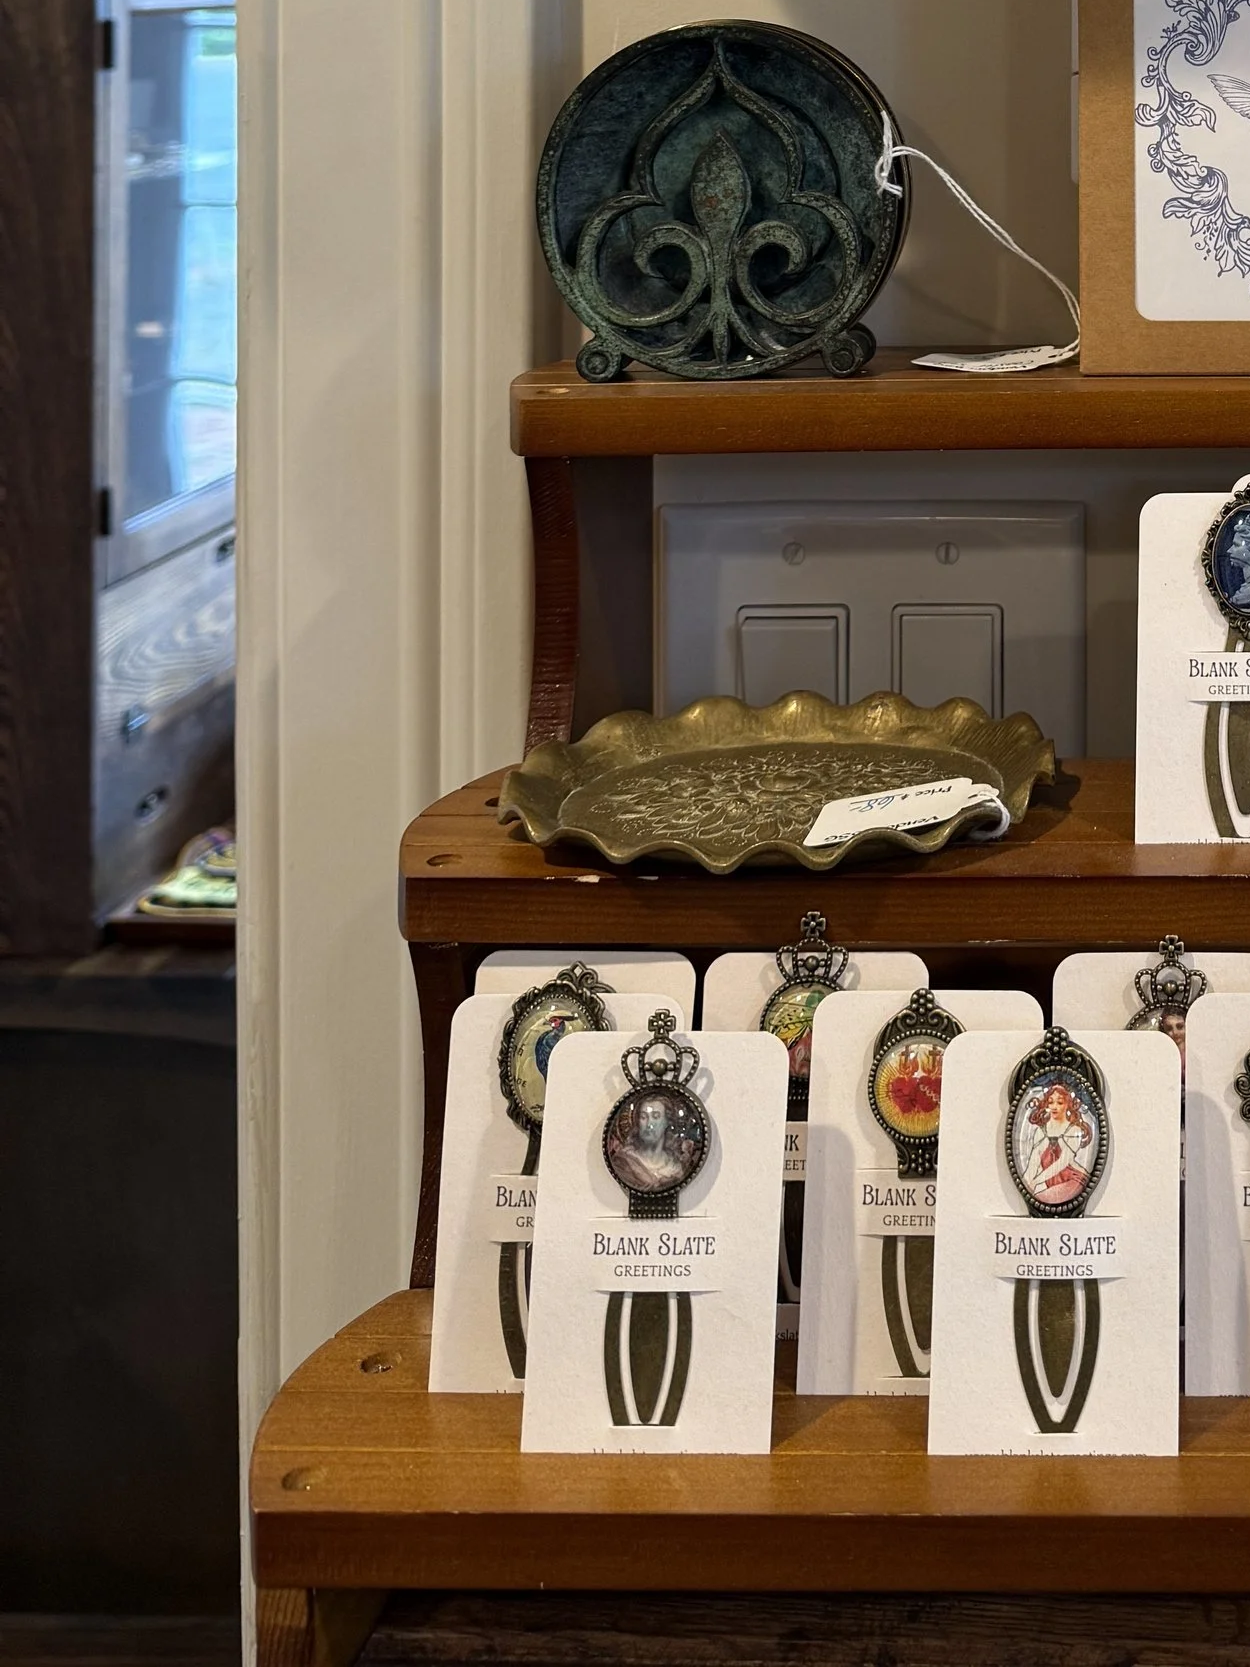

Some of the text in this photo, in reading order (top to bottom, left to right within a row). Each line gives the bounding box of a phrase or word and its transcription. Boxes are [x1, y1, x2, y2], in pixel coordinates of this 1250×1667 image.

[1188, 658, 1239, 678] BLANK
[495, 1185, 538, 1208] BLAN
[862, 1184, 917, 1207] BLANK
[593, 1232, 716, 1255] BLANK SLATE
[994, 1232, 1117, 1256] BLANK SLATE
[613, 1264, 692, 1277] GREETINGS
[1016, 1264, 1094, 1277] GREETINGS
